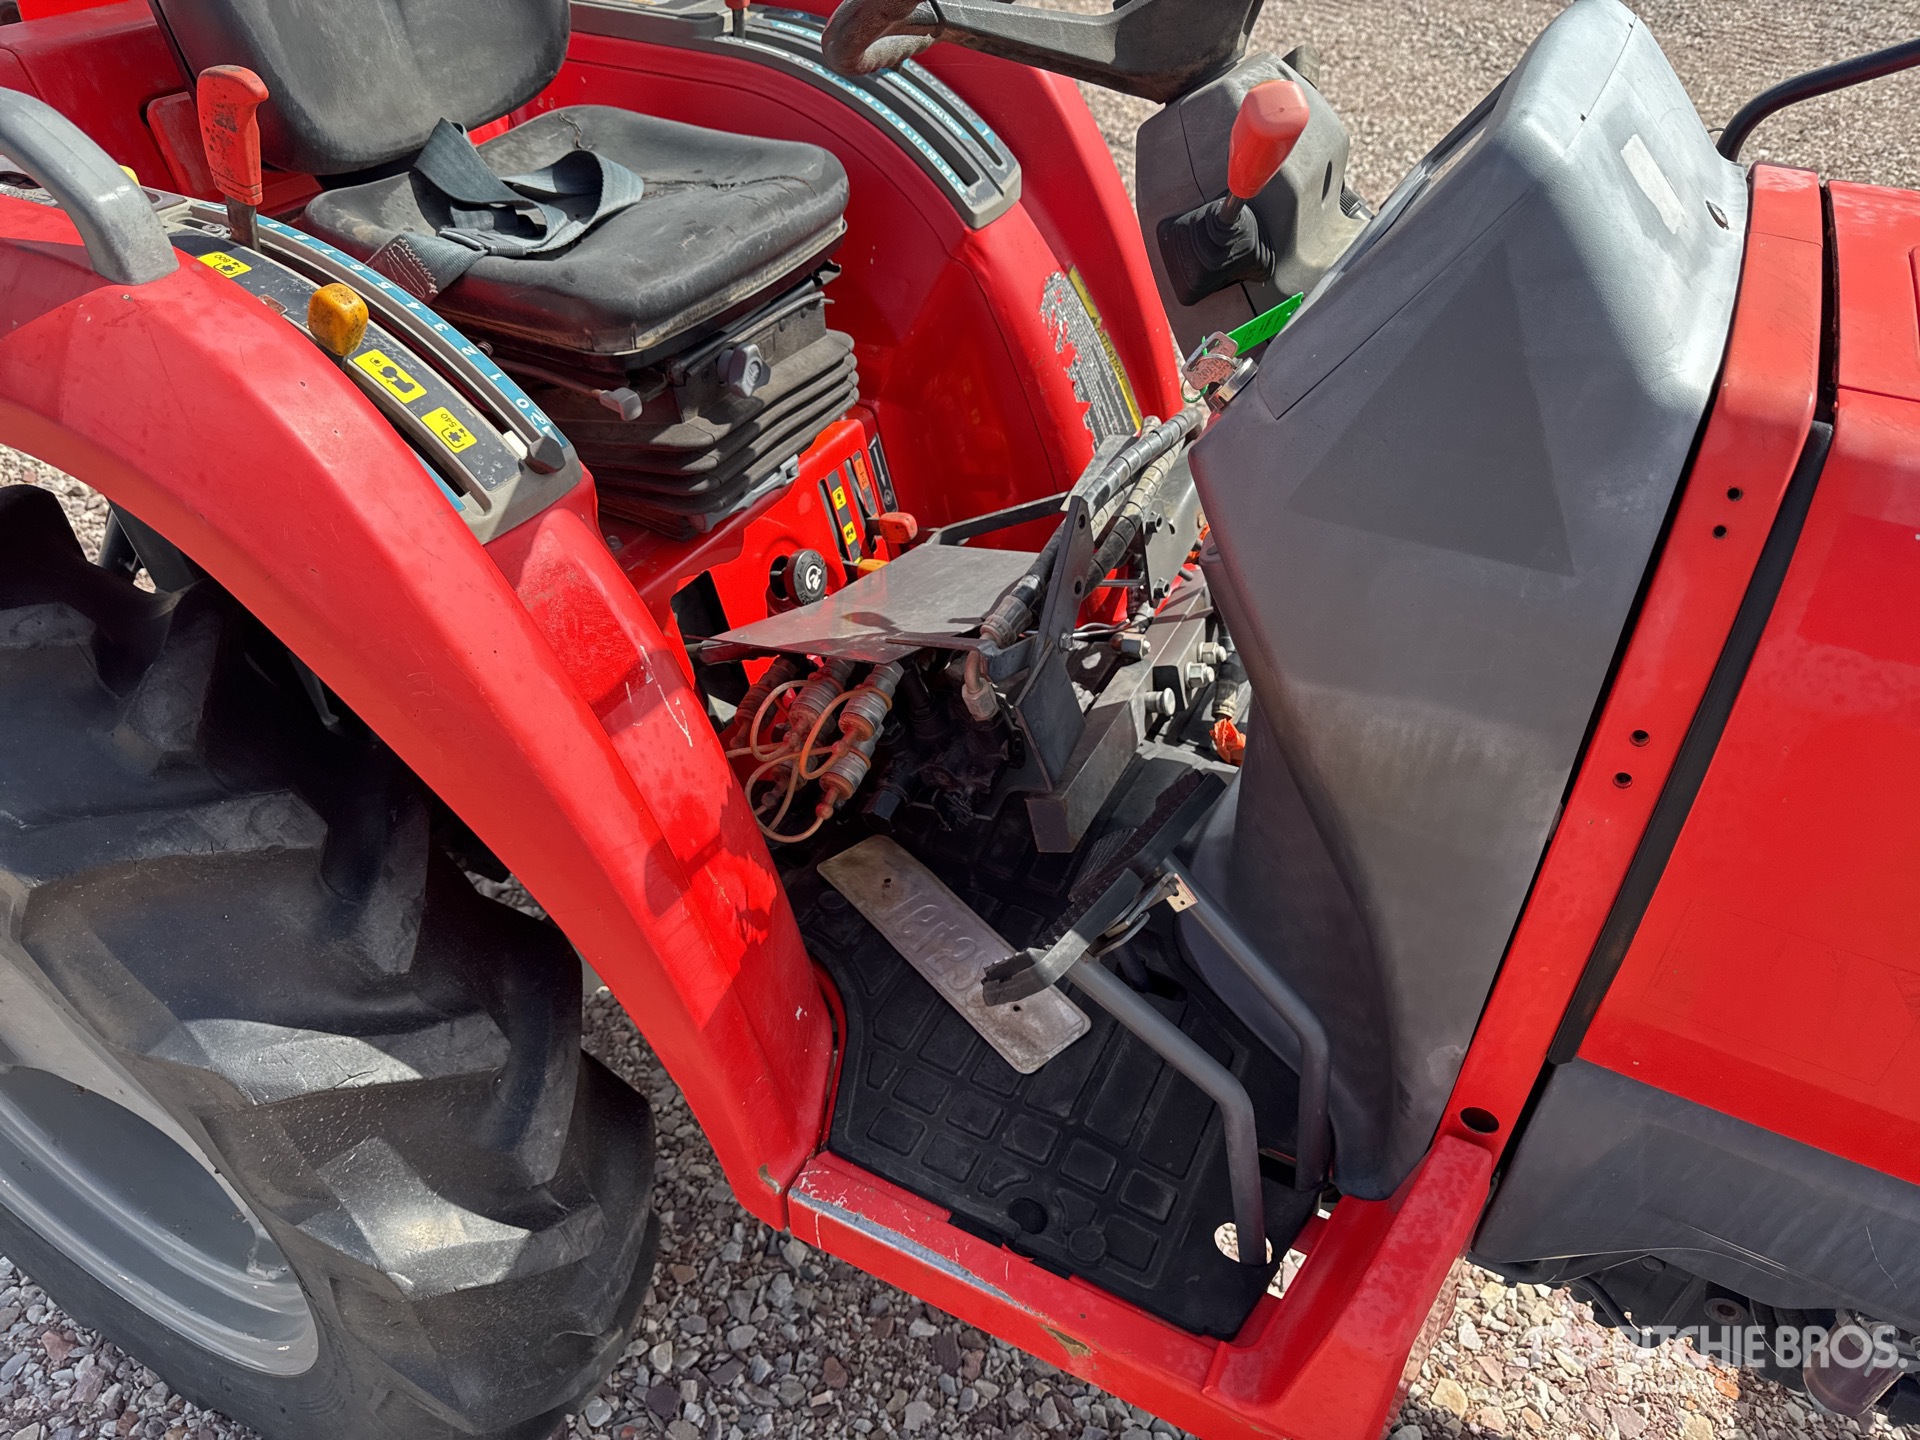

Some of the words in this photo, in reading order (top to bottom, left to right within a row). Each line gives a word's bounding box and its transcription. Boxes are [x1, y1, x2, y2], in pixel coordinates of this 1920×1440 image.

[376, 281, 393, 289] 5
[406, 301, 421, 310] 4
[433, 323, 449, 332] 3
[461, 345, 478, 356] 2
[489, 372, 502, 381] 1
[515, 398, 530, 409] 0
[440, 413, 458, 428] 540
